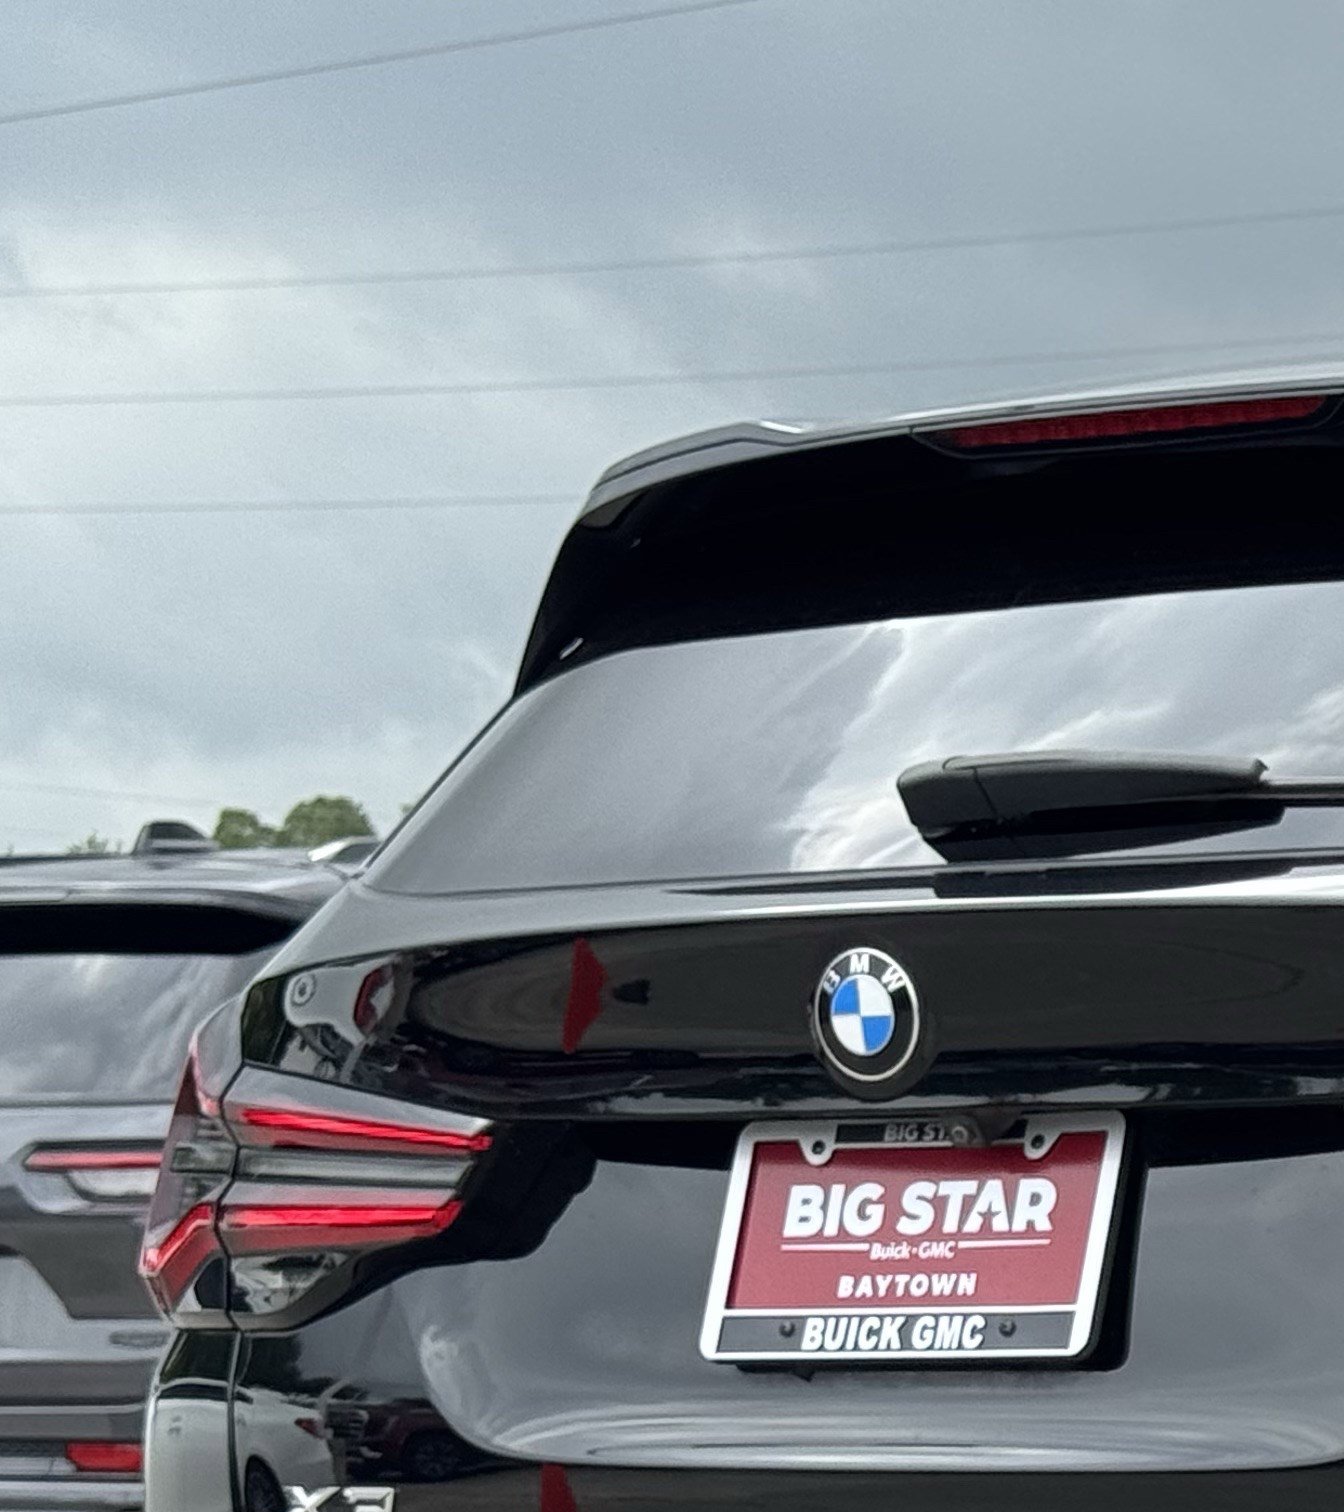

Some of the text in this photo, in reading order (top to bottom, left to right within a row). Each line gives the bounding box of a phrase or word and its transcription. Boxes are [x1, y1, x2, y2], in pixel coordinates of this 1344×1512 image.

[823, 953, 907, 994] BMW
[884, 1123, 919, 1142] BIG
[782, 1177, 1057, 1238] BIG STAR
[836, 1272, 977, 1299] BAYTOWN
[801, 1314, 986, 1351] BUICK GMC
